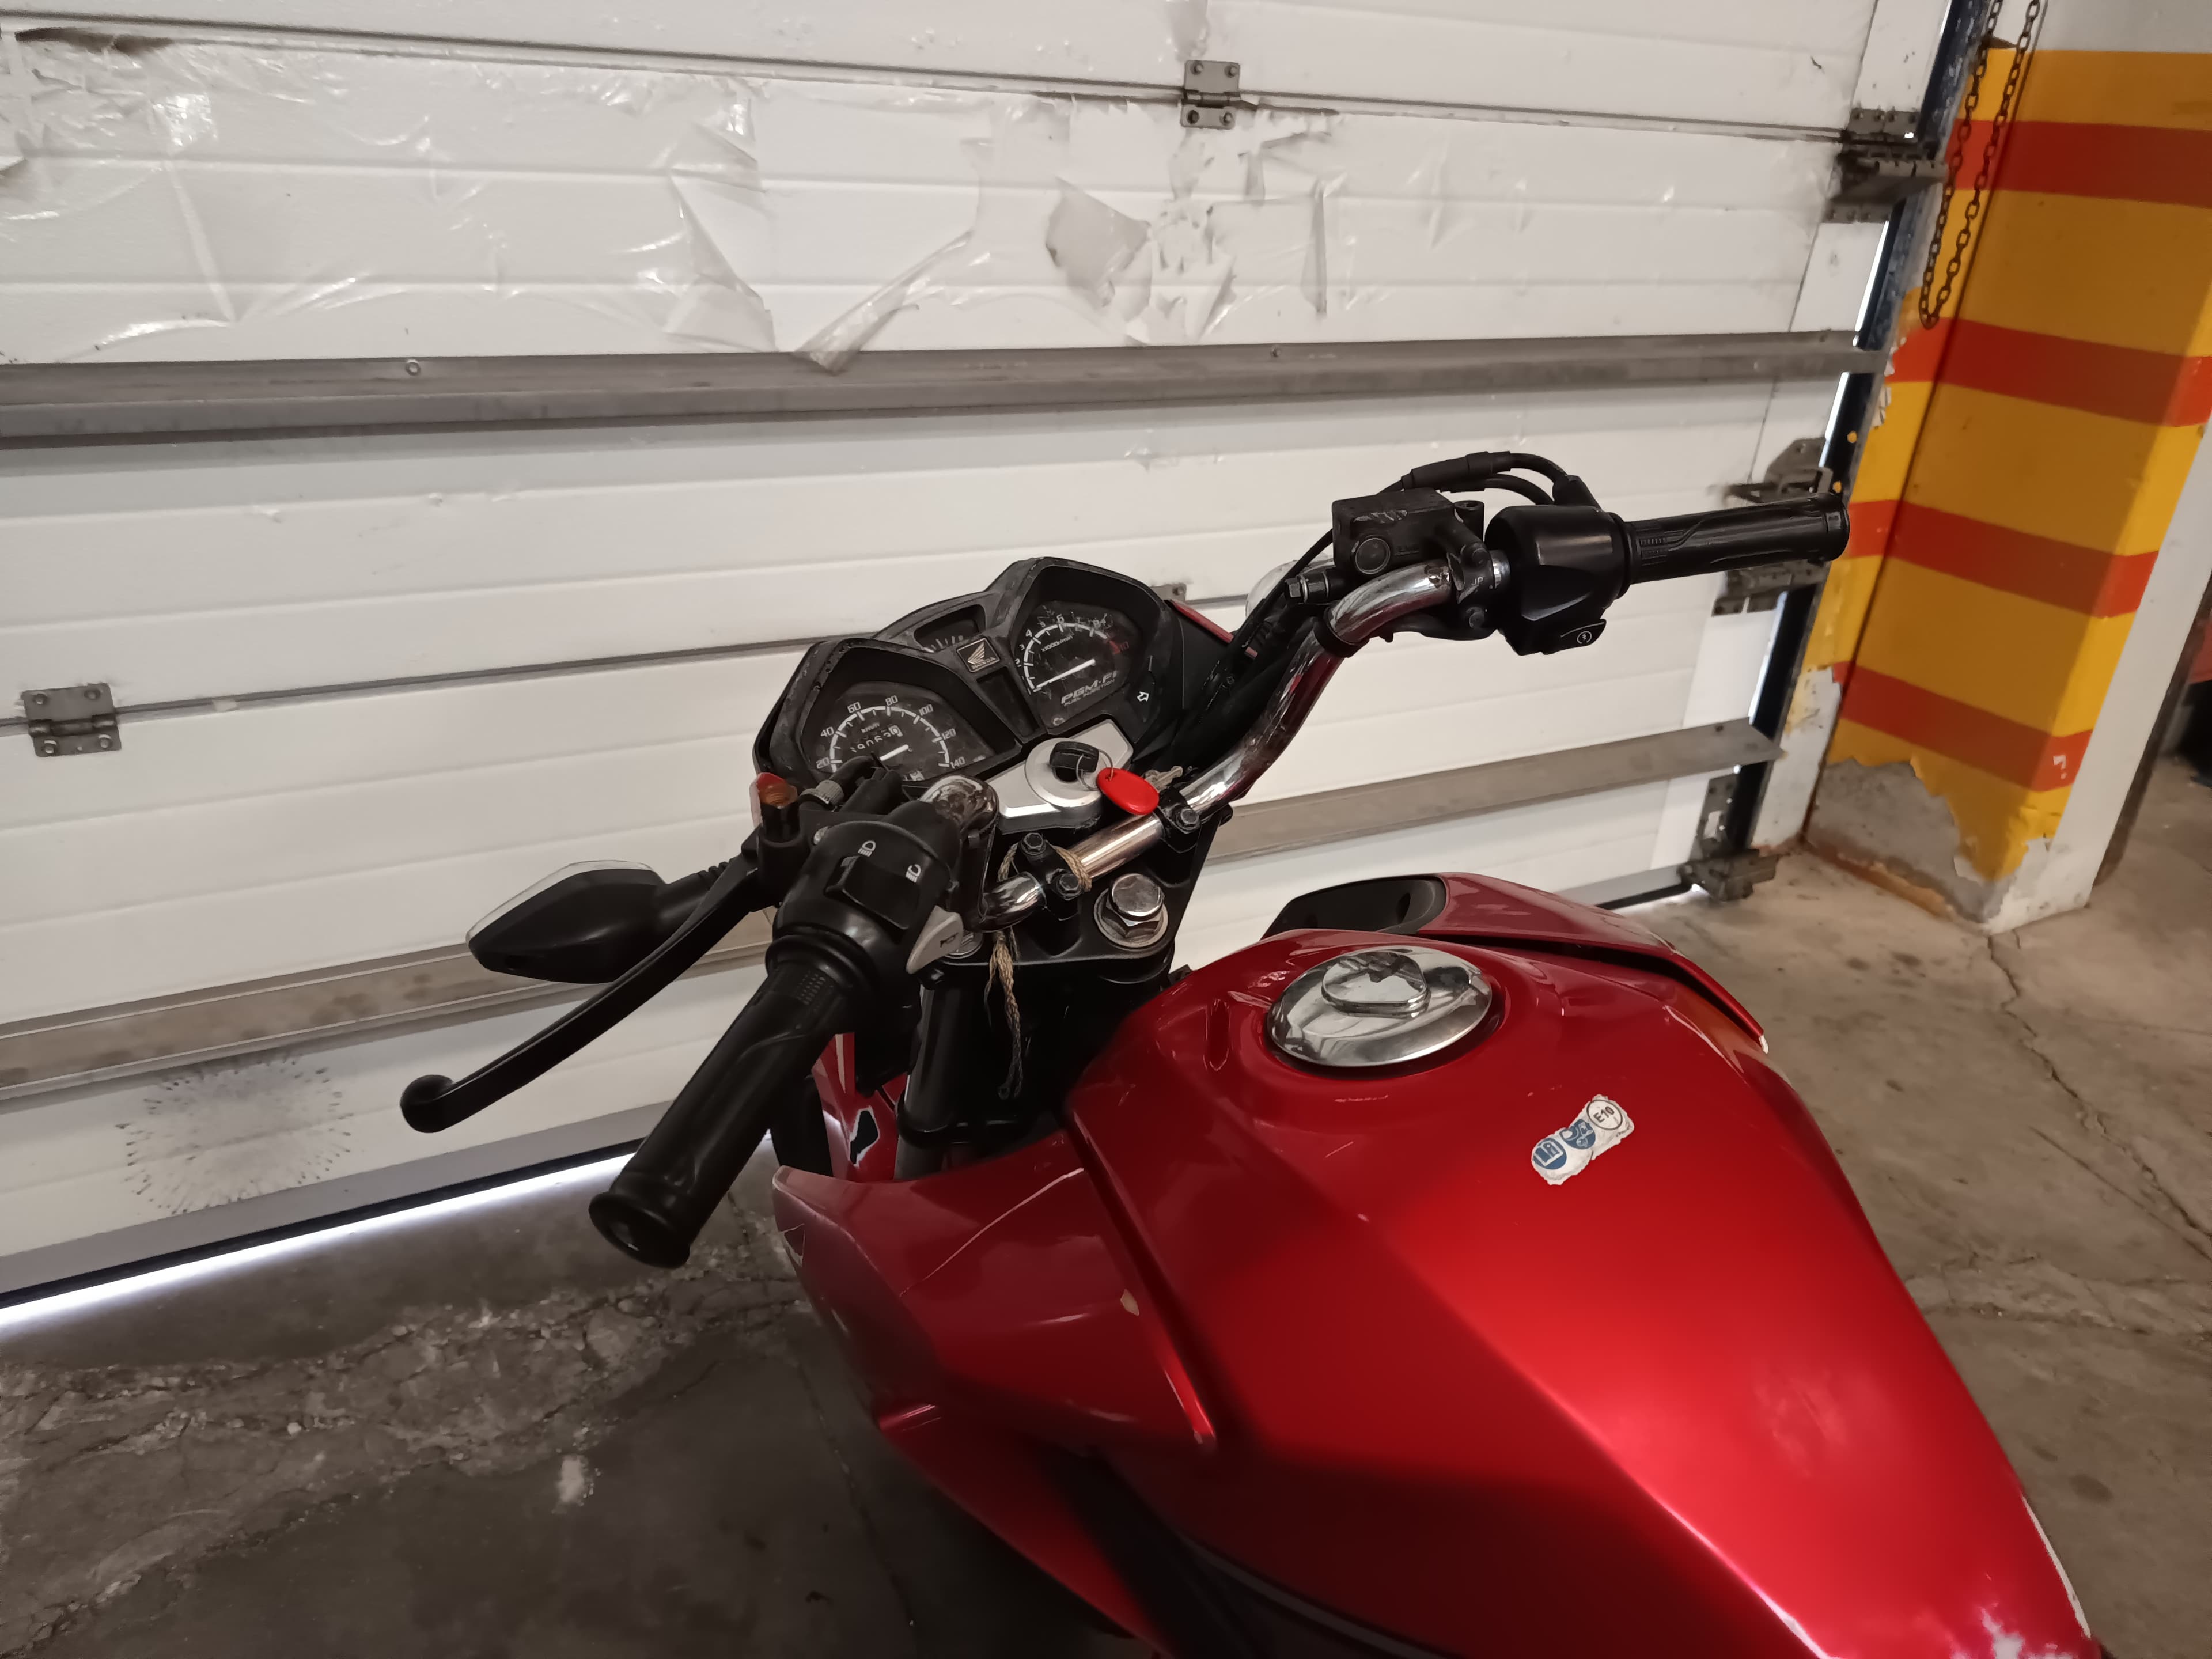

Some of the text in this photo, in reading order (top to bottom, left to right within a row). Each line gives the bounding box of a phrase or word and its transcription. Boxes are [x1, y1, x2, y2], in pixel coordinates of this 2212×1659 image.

[1056, 614, 1065, 623] 6
[1025, 629, 1033, 638] 4
[971, 657, 996, 670] HONDA
[885, 695, 899, 706] 80
[1063, 697, 1082, 707] FUEL
[847, 702, 861, 714] 60
[918, 704, 934, 717] 100
[820, 726, 835, 737] 40
[861, 722, 880, 733] km/h
[942, 728, 956, 740] 120
[816, 757, 830, 770] 20
[950, 756, 965, 769] 140
[1593, 1105, 1615, 1123] E10
